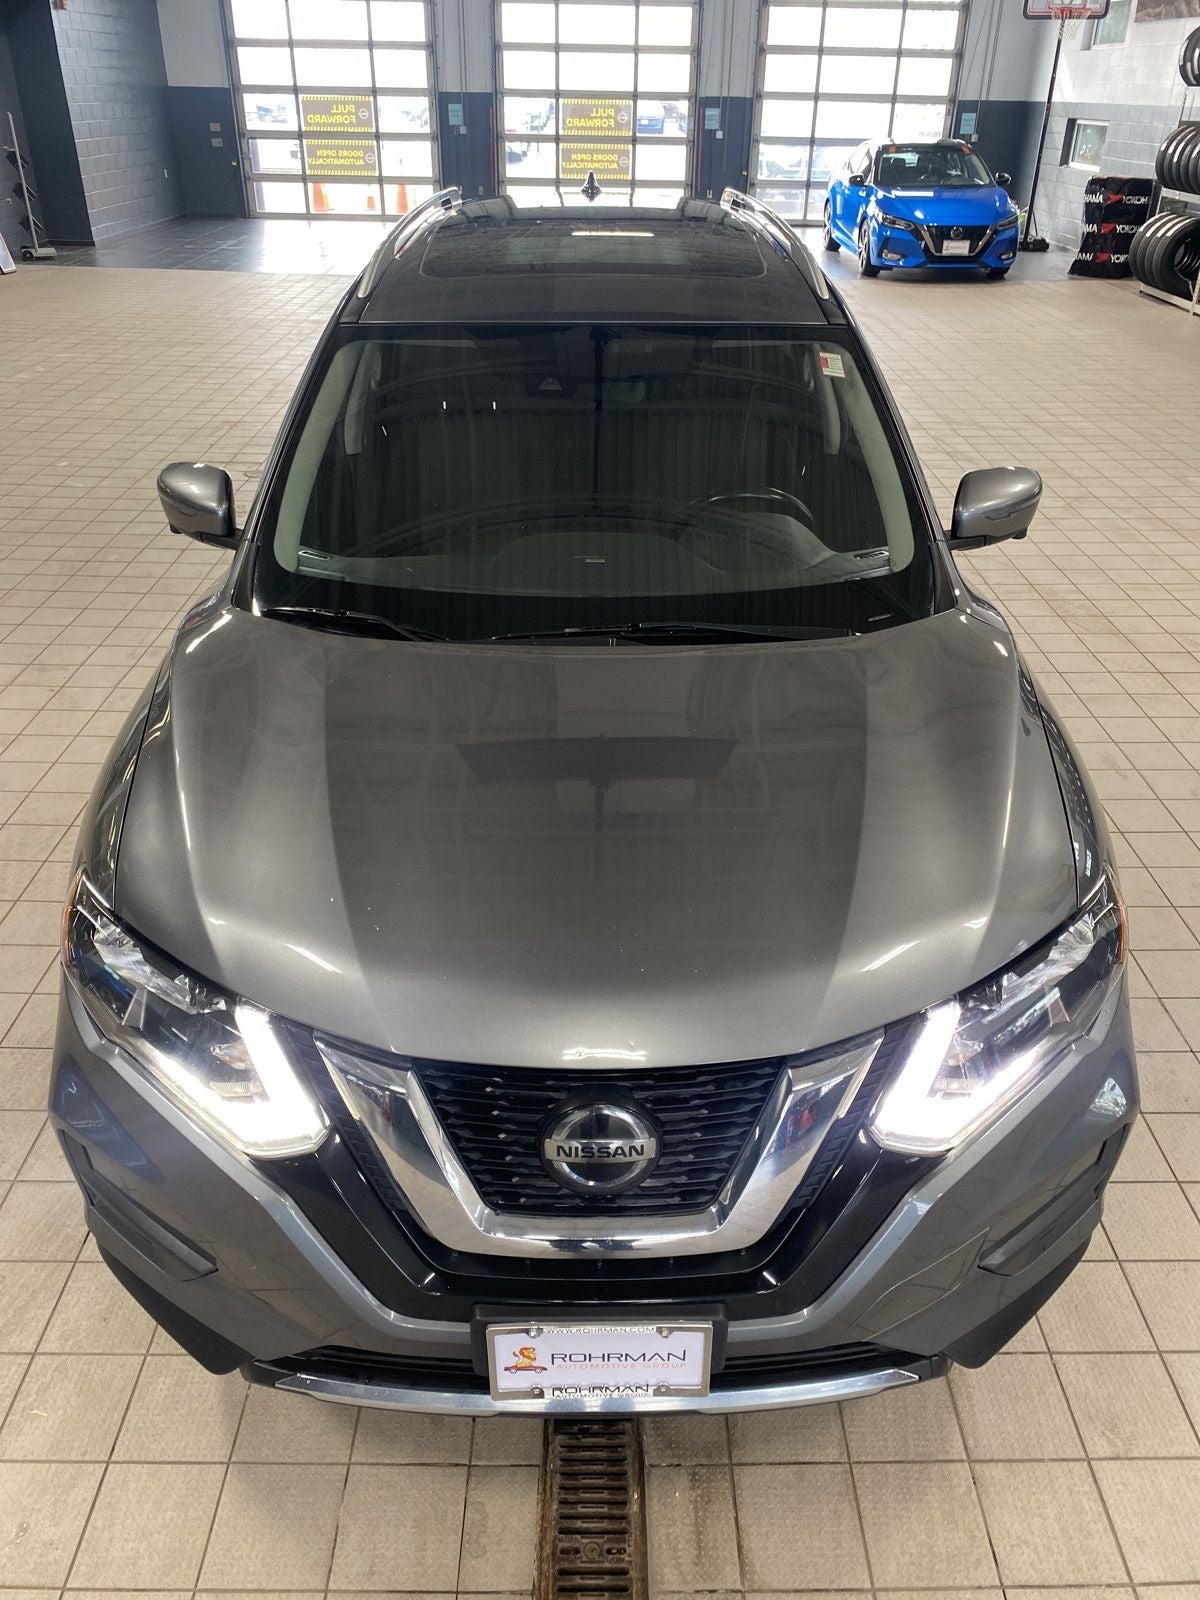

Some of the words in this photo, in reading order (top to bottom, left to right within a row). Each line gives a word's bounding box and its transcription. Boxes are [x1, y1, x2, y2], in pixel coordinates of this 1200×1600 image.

[556, 1144, 645, 1159] NISSAN
[551, 1349, 686, 1365] ROHRMAN
[552, 1384, 649, 1396] ROHRMAN
